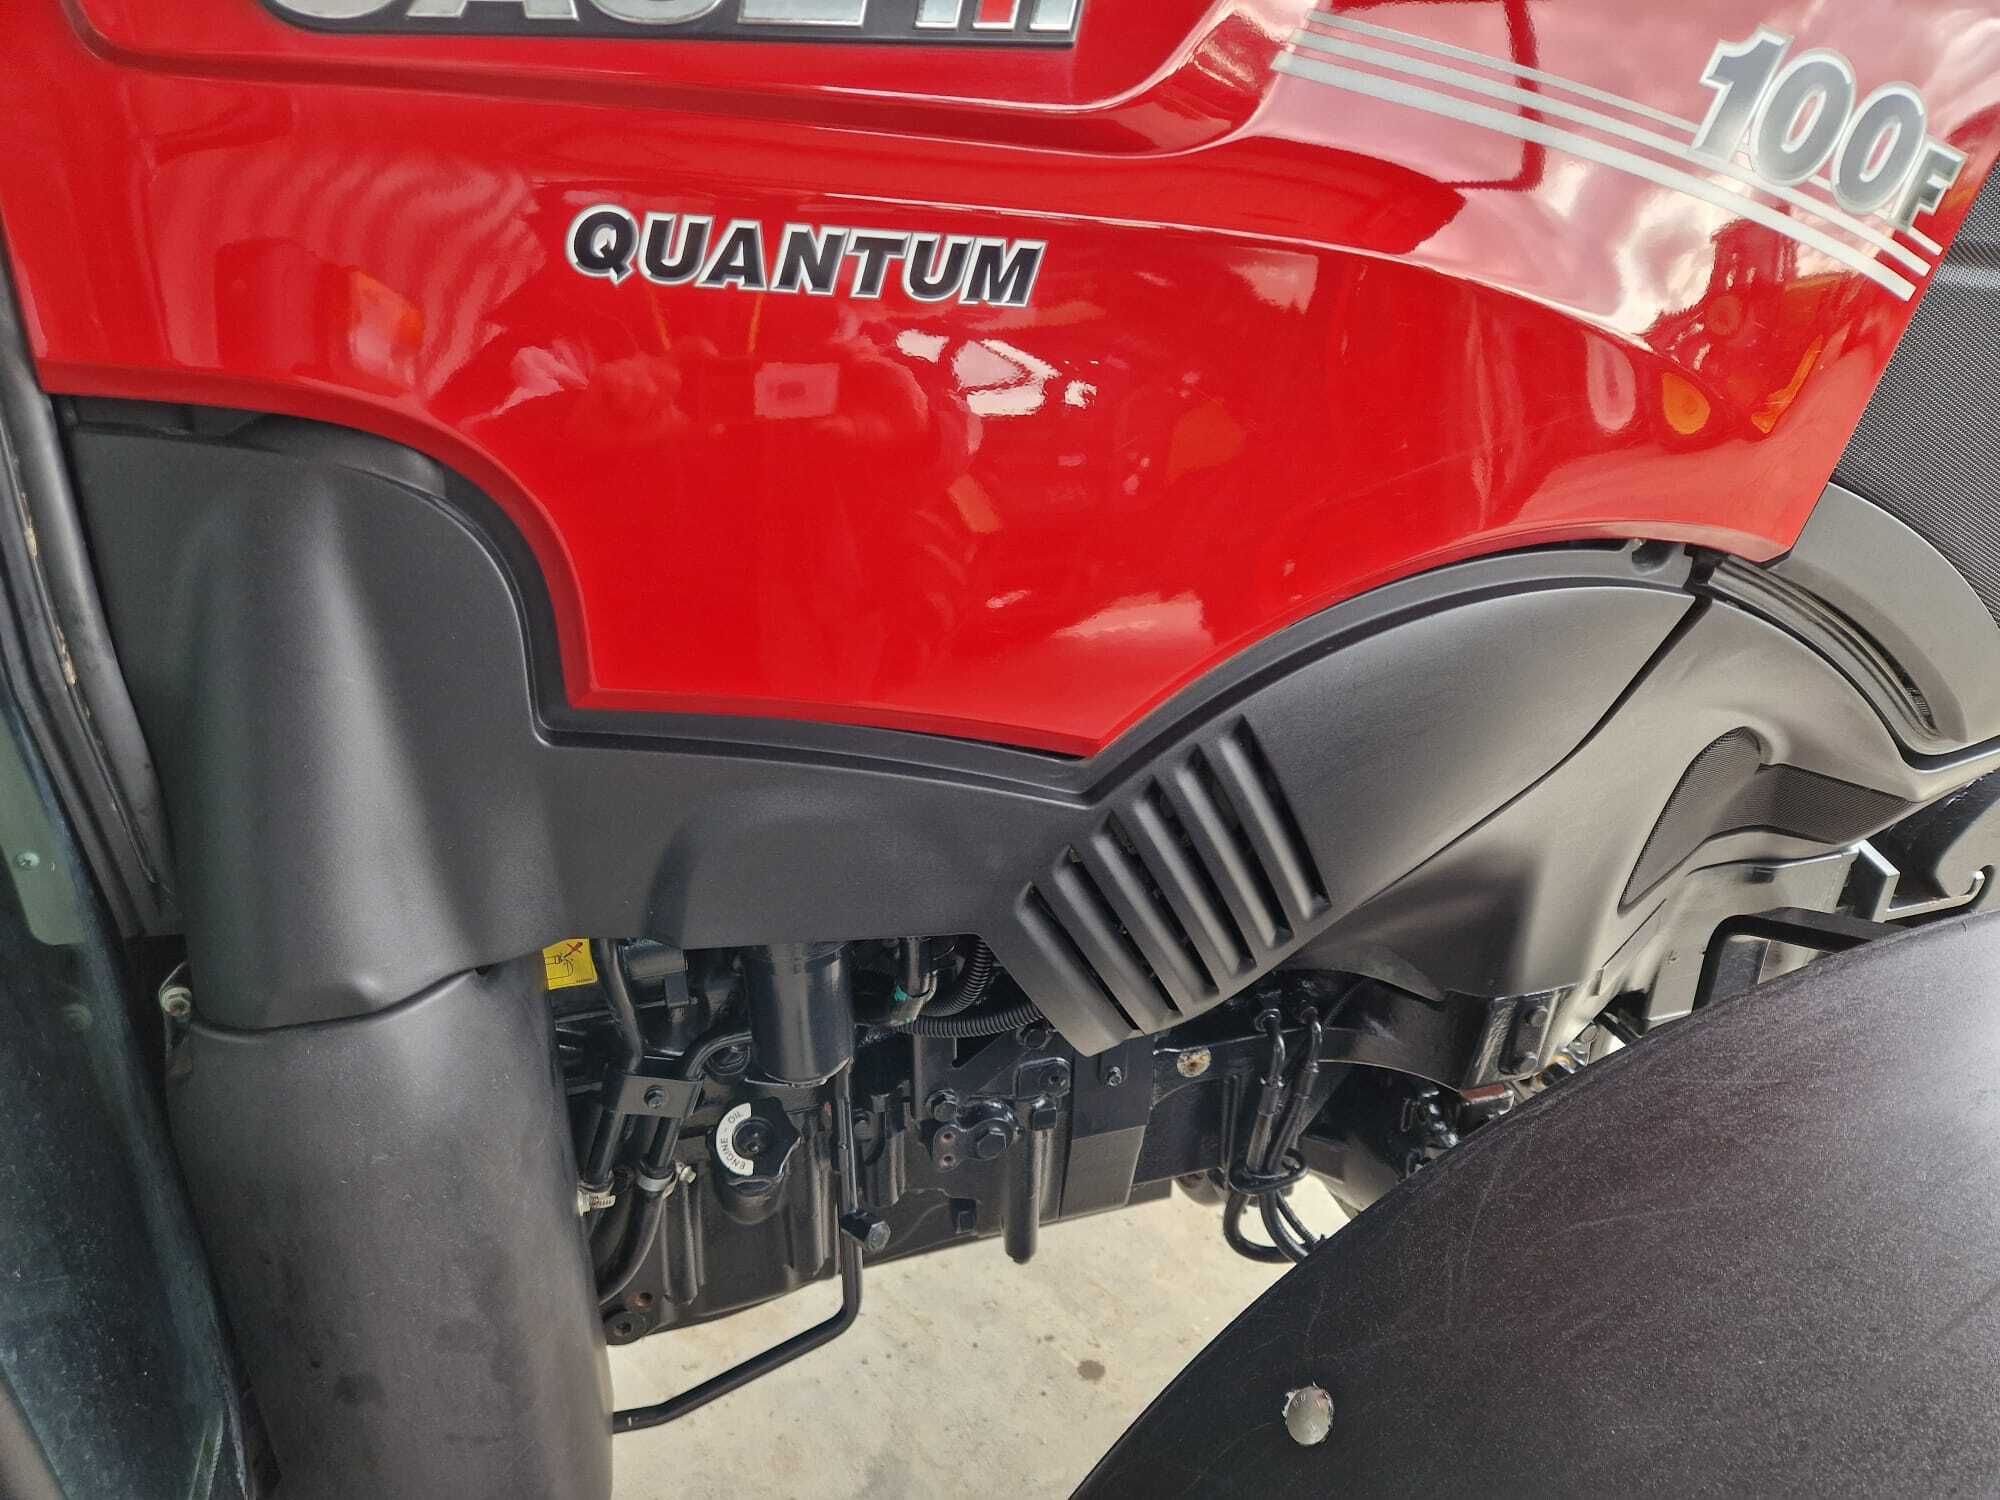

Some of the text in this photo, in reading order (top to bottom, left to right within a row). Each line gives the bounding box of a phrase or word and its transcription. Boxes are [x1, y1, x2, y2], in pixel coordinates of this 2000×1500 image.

[1689, 24, 1968, 233] 100F
[566, 203, 1048, 308] QUANTUM
[721, 1110, 746, 1169] ENGINE OIL
